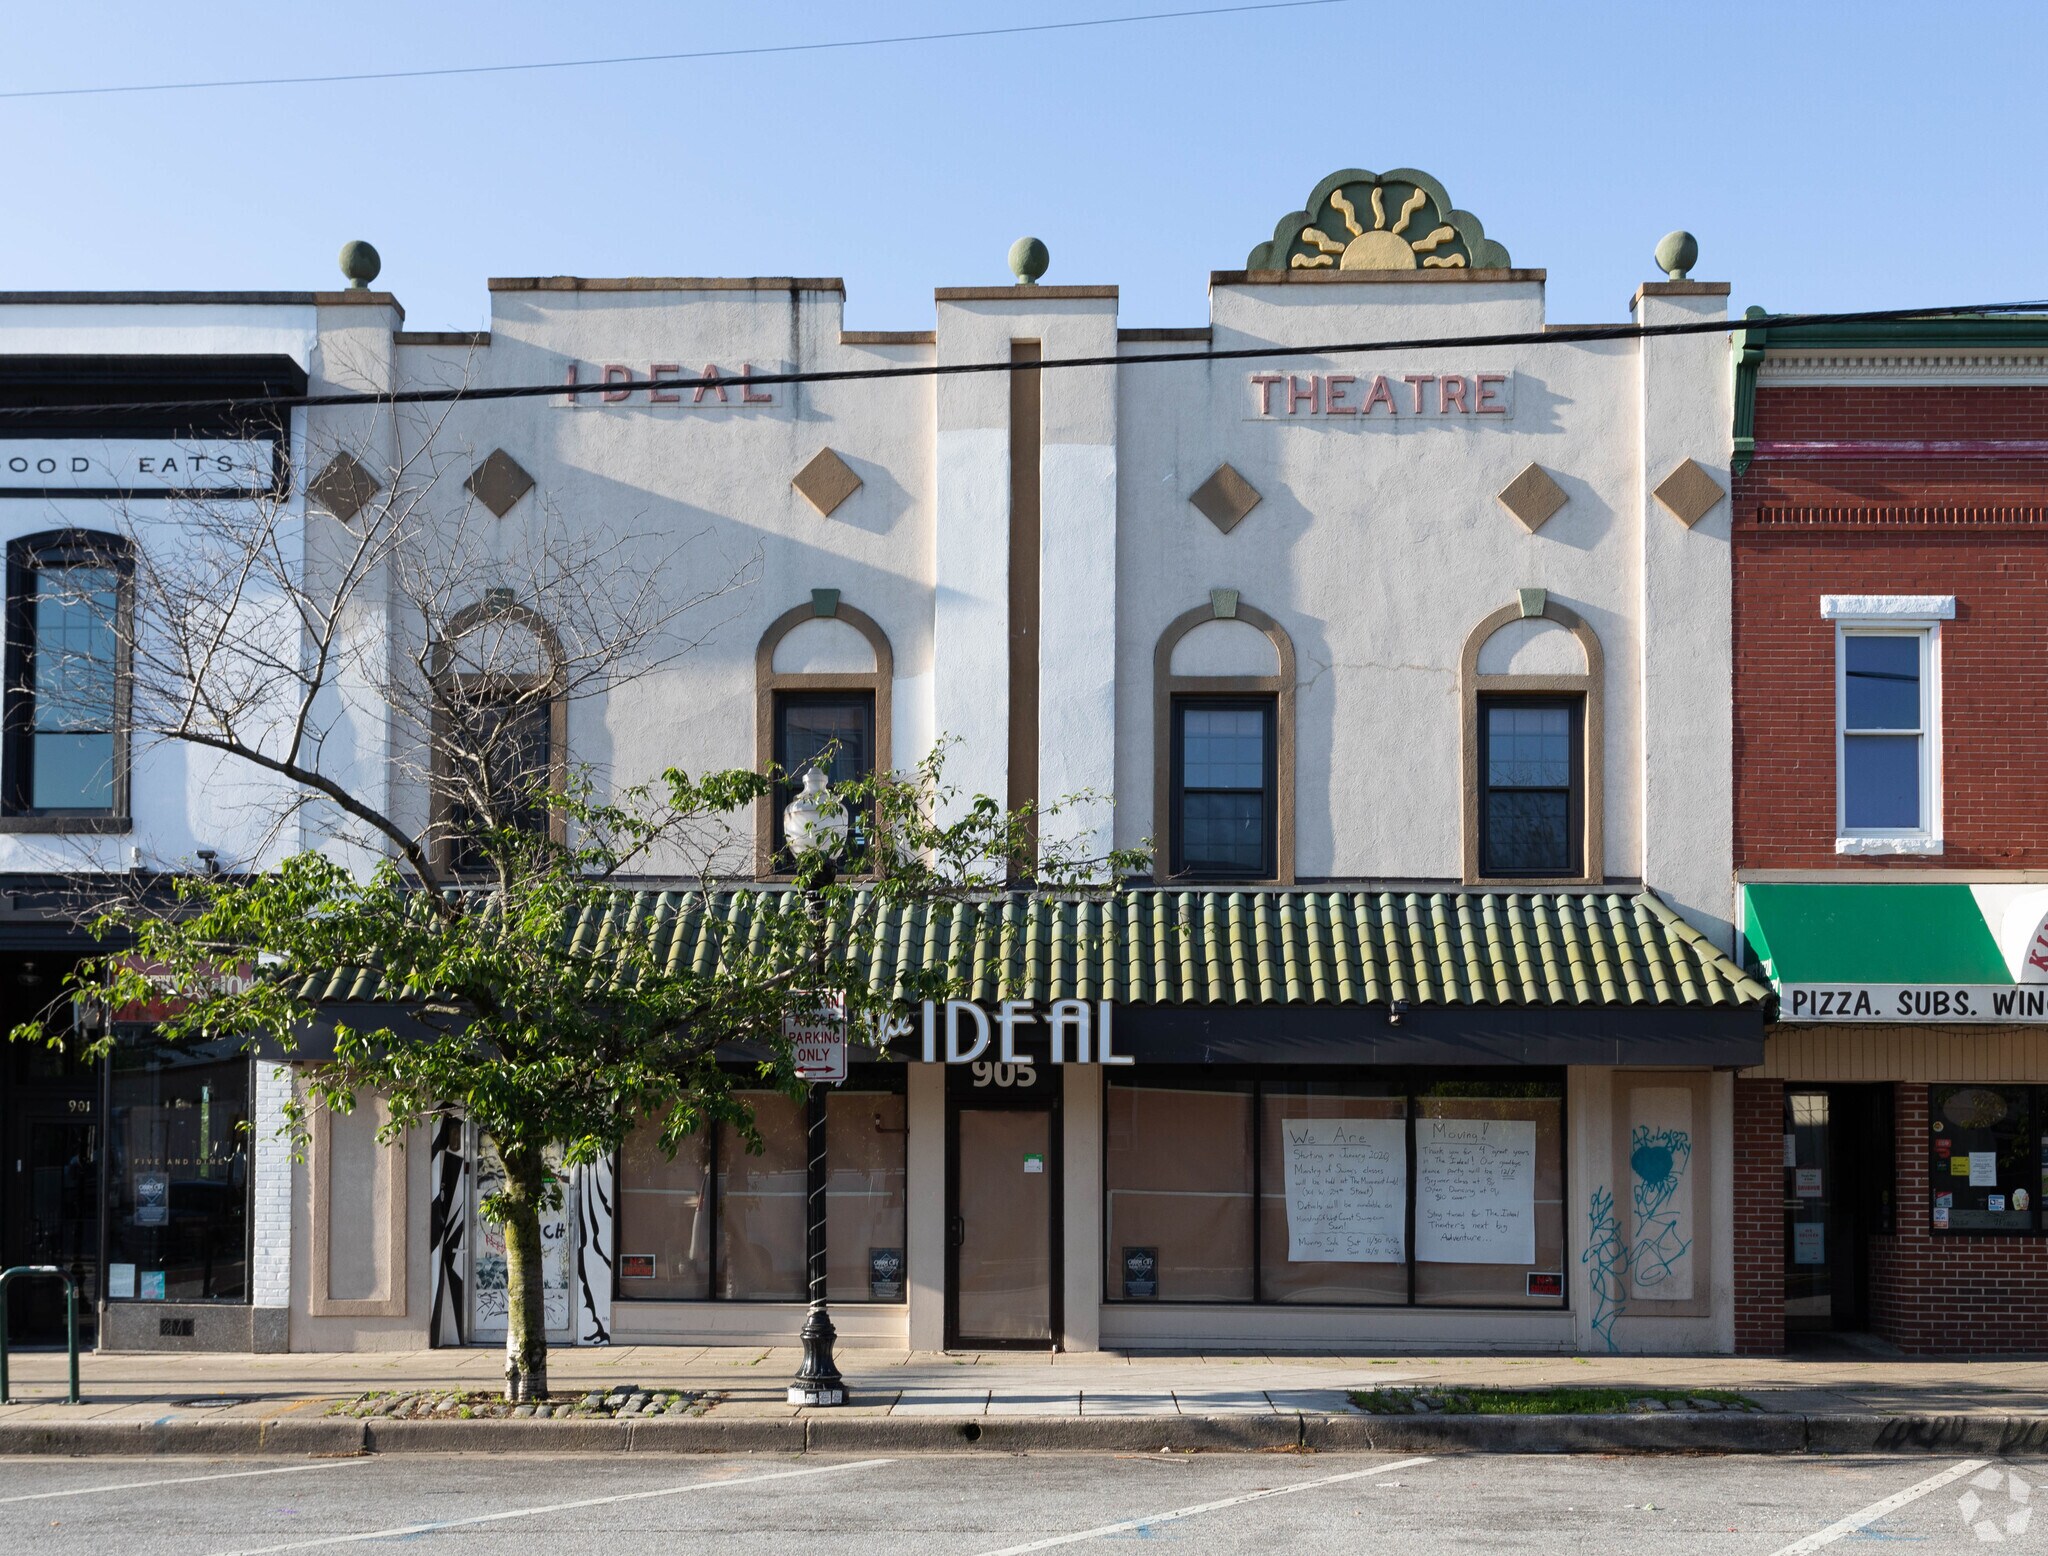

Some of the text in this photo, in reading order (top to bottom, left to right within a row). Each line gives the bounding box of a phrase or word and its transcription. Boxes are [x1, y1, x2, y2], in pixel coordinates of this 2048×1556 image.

[567, 363, 772, 402] IDEAL
[1251, 375, 1505, 414] THEATRE
[0, 455, 234, 474] OOD EATS
[1792, 990, 2048, 1016] PIZZA. SUBS. WIN
[788, 1031, 840, 1044] PARKING
[922, 998, 1135, 1065] IDEAL
[798, 1048, 830, 1061] ONLY
[972, 1062, 1037, 1087] 905
[68, 1100, 91, 1112] 901
[1289, 1126, 1367, 1144] We Are
[134, 1158, 224, 1166] FIVE AND DIME
